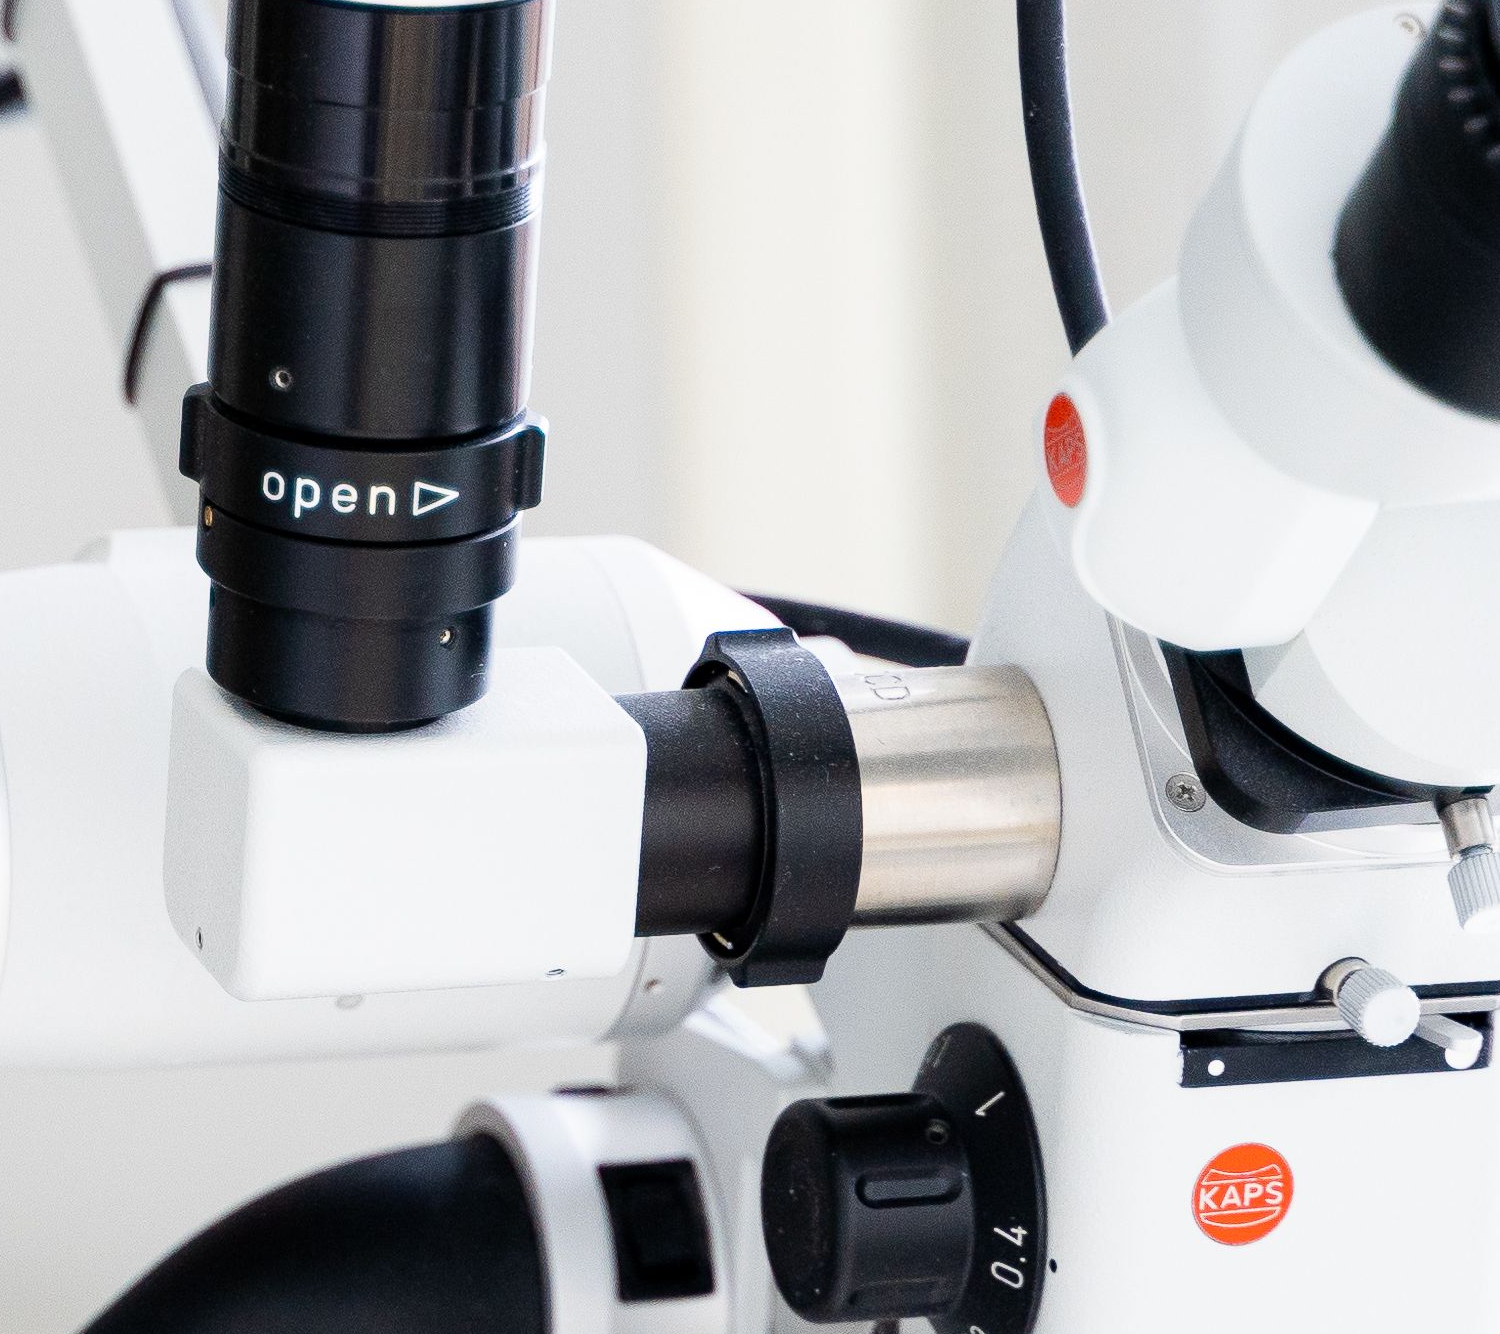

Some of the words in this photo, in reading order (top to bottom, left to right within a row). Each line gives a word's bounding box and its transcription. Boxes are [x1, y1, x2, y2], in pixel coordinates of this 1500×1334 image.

[262, 471, 396, 519] open
[1199, 1181, 1284, 1211] KAPS
[990, 1226, 1028, 1289] 0.4
